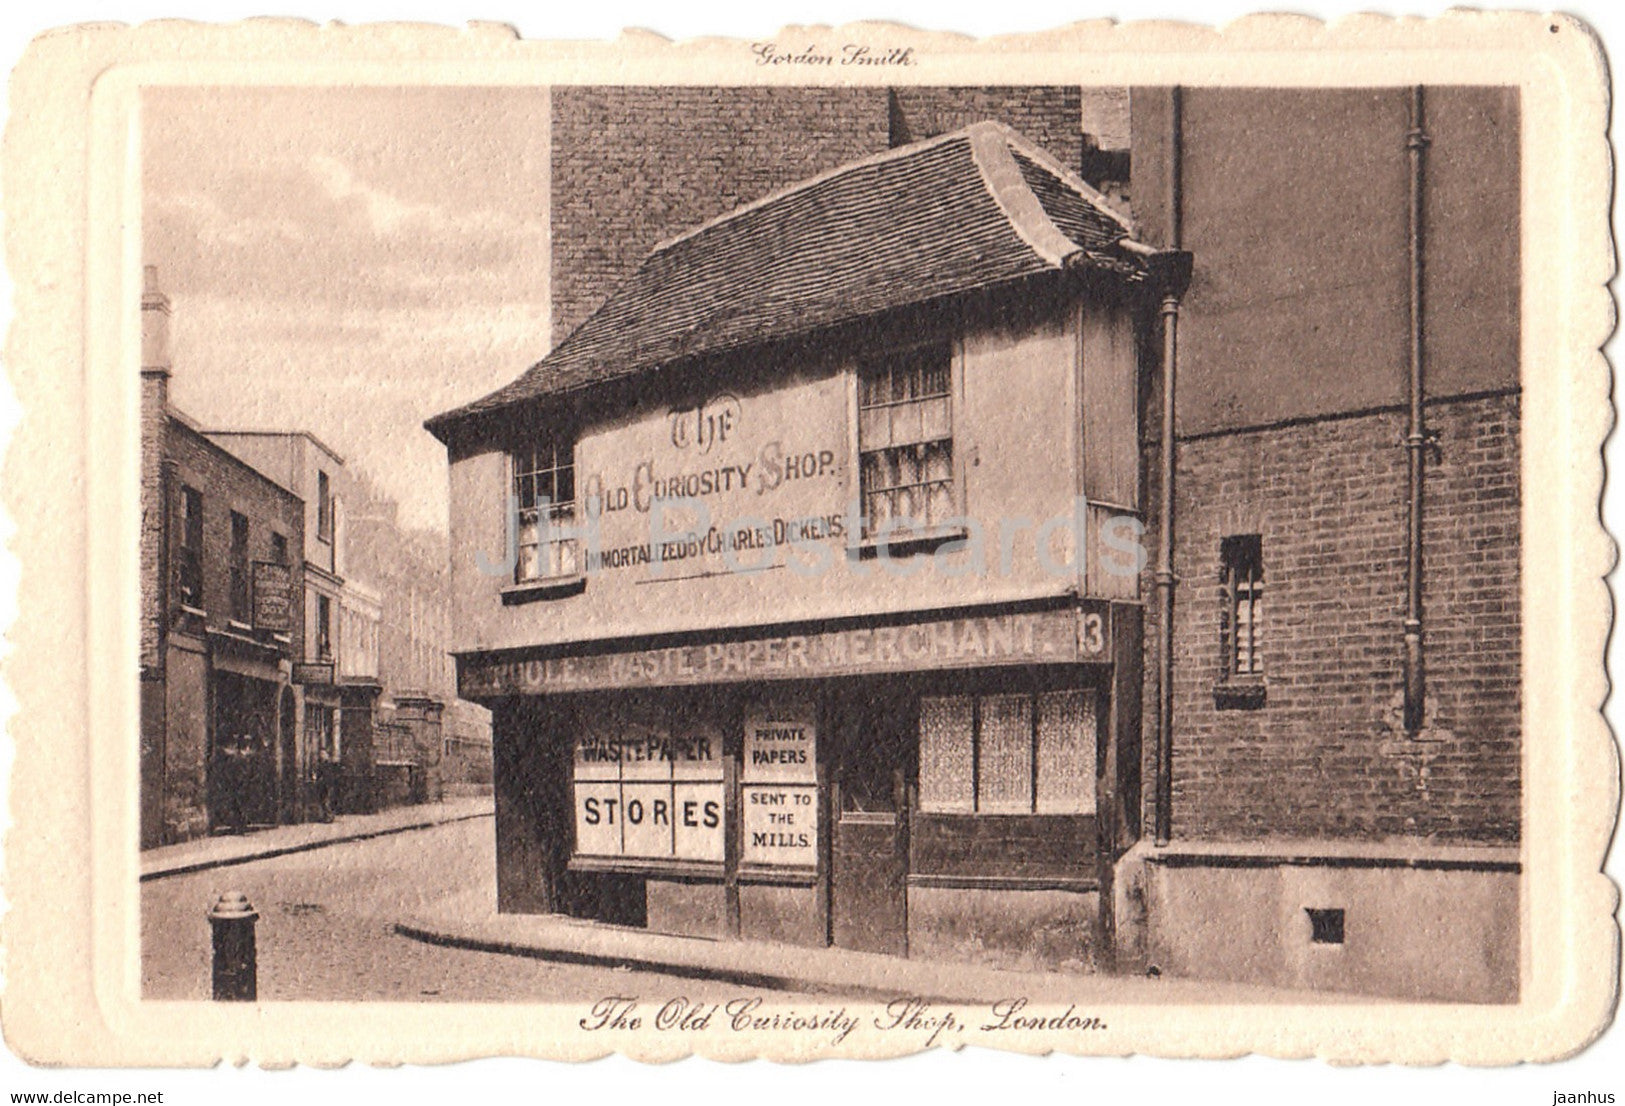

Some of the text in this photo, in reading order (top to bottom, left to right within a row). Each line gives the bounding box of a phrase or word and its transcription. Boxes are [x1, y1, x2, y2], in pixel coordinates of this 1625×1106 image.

[1075, 607, 1103, 653] 13
[755, 728, 806, 743] PRIVATE
[753, 749, 807, 765] PAPERS
[751, 794, 811, 806] SENT TO
[585, 797, 719, 829] STORES
[770, 813, 794, 825] THE
